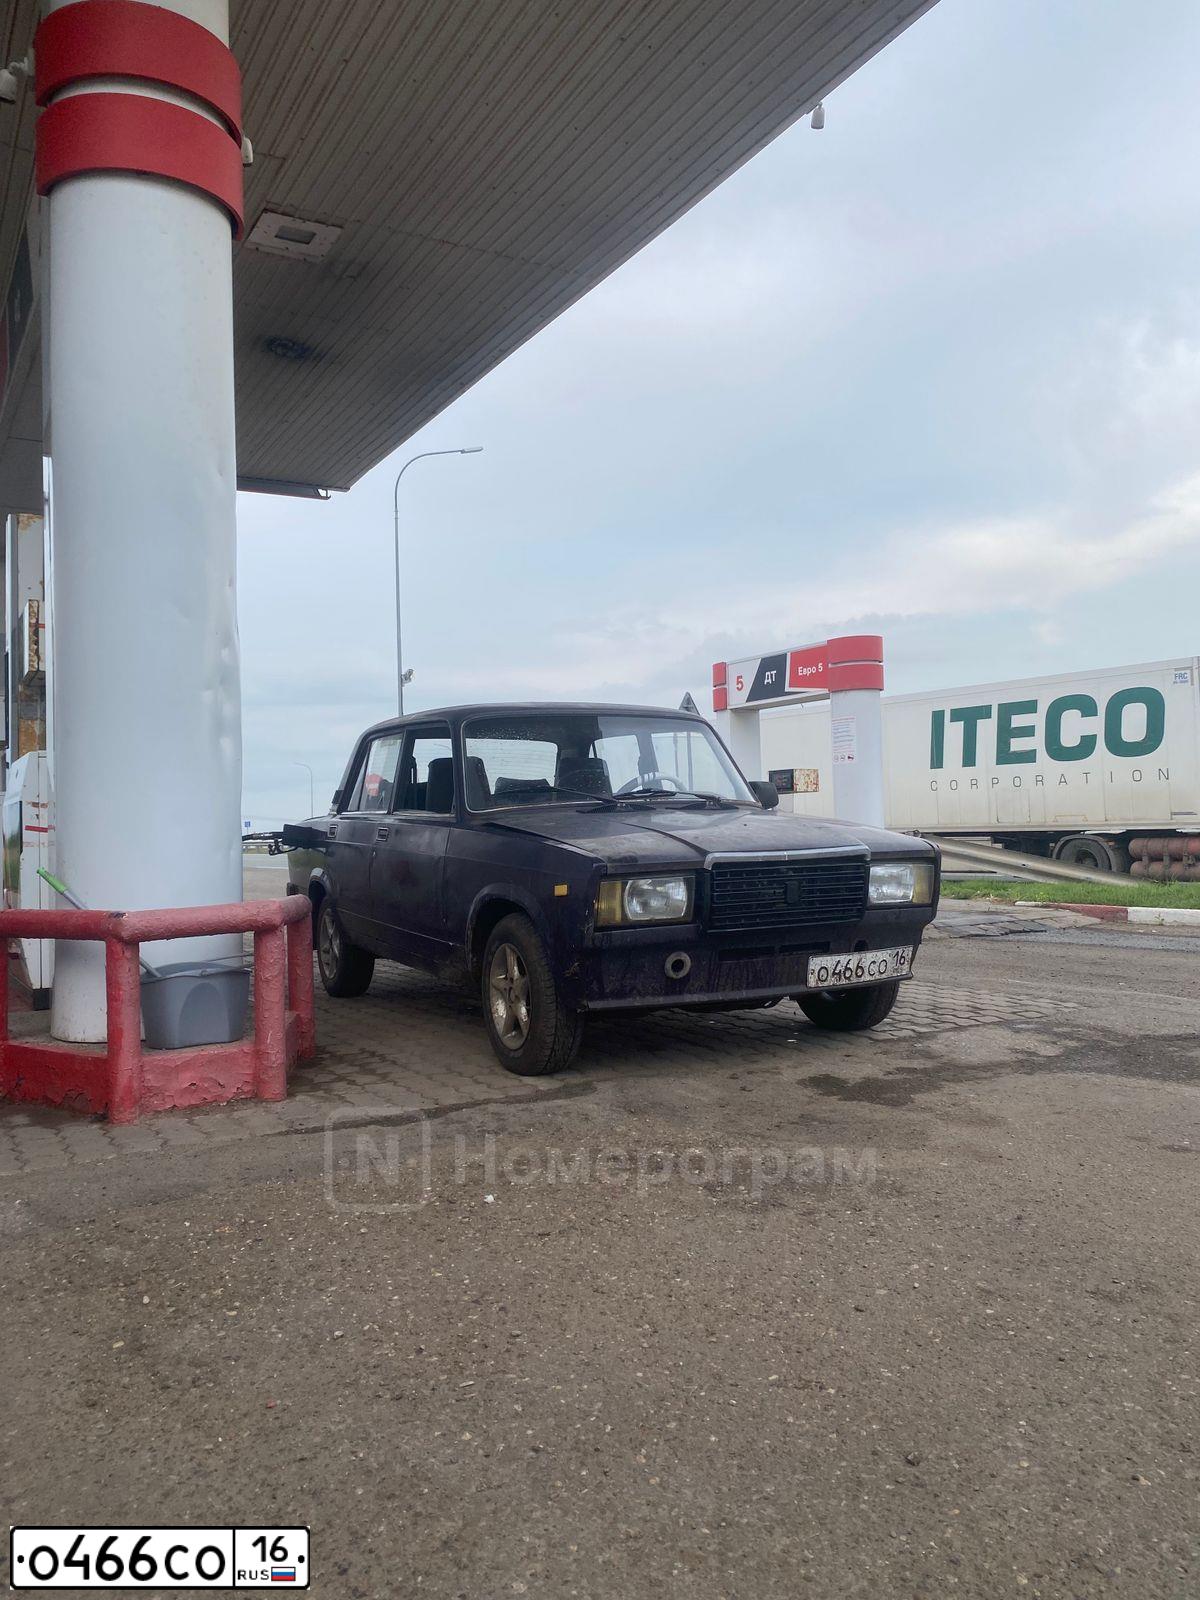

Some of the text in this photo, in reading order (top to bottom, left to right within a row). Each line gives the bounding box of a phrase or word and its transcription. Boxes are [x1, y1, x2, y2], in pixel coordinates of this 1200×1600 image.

[735, 662, 823, 691] 5 ДТ Евро 5
[1174, 672, 1188, 680] FRC
[930, 686, 1165, 769] ITECO
[930, 767, 1170, 792] CORPORATION
